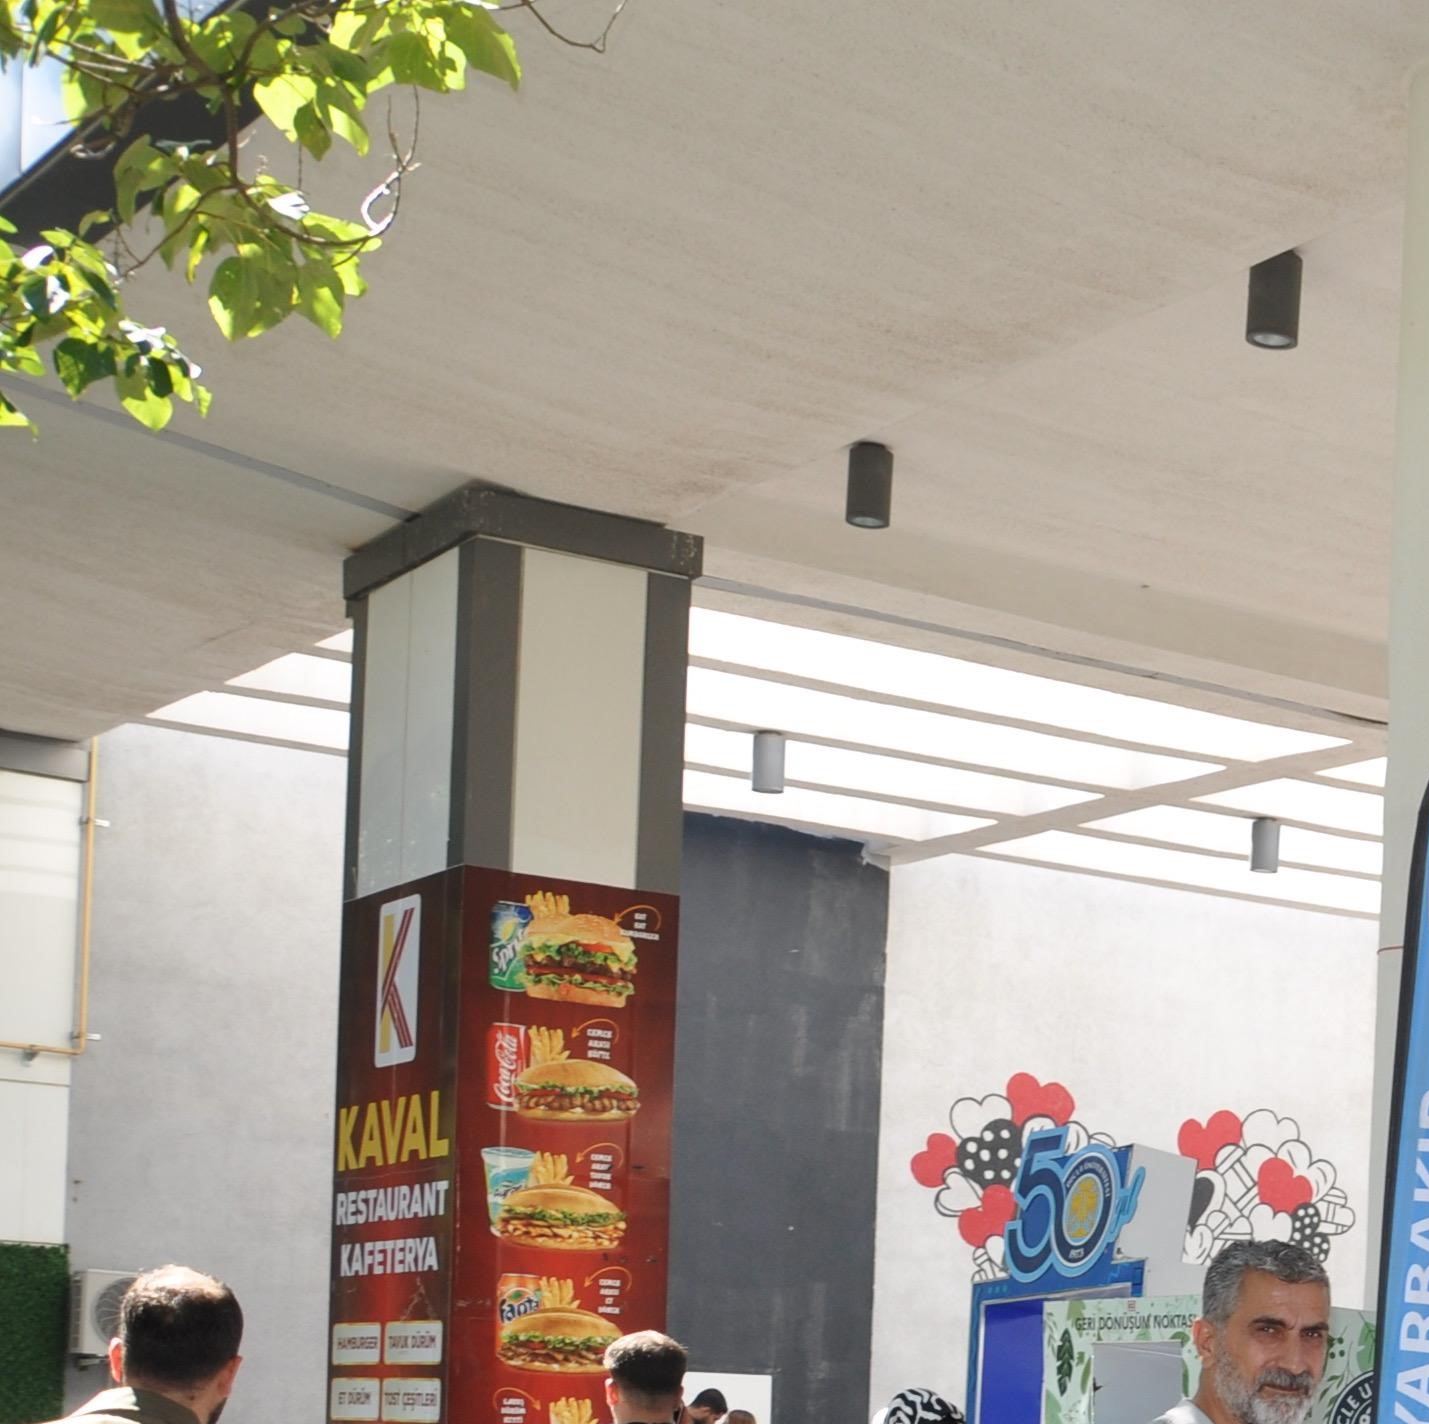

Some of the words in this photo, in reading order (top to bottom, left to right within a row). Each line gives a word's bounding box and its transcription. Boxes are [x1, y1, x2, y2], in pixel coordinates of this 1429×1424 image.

[337, 1090, 449, 1172] KAVAL
[336, 1180, 449, 1226] RESTAURANT
[340, 1236, 439, 1277] KAFETERYA
[1075, 1313, 1096, 1331] GERİ
[1099, 1311, 1151, 1334] DÖNÜŞÜM
